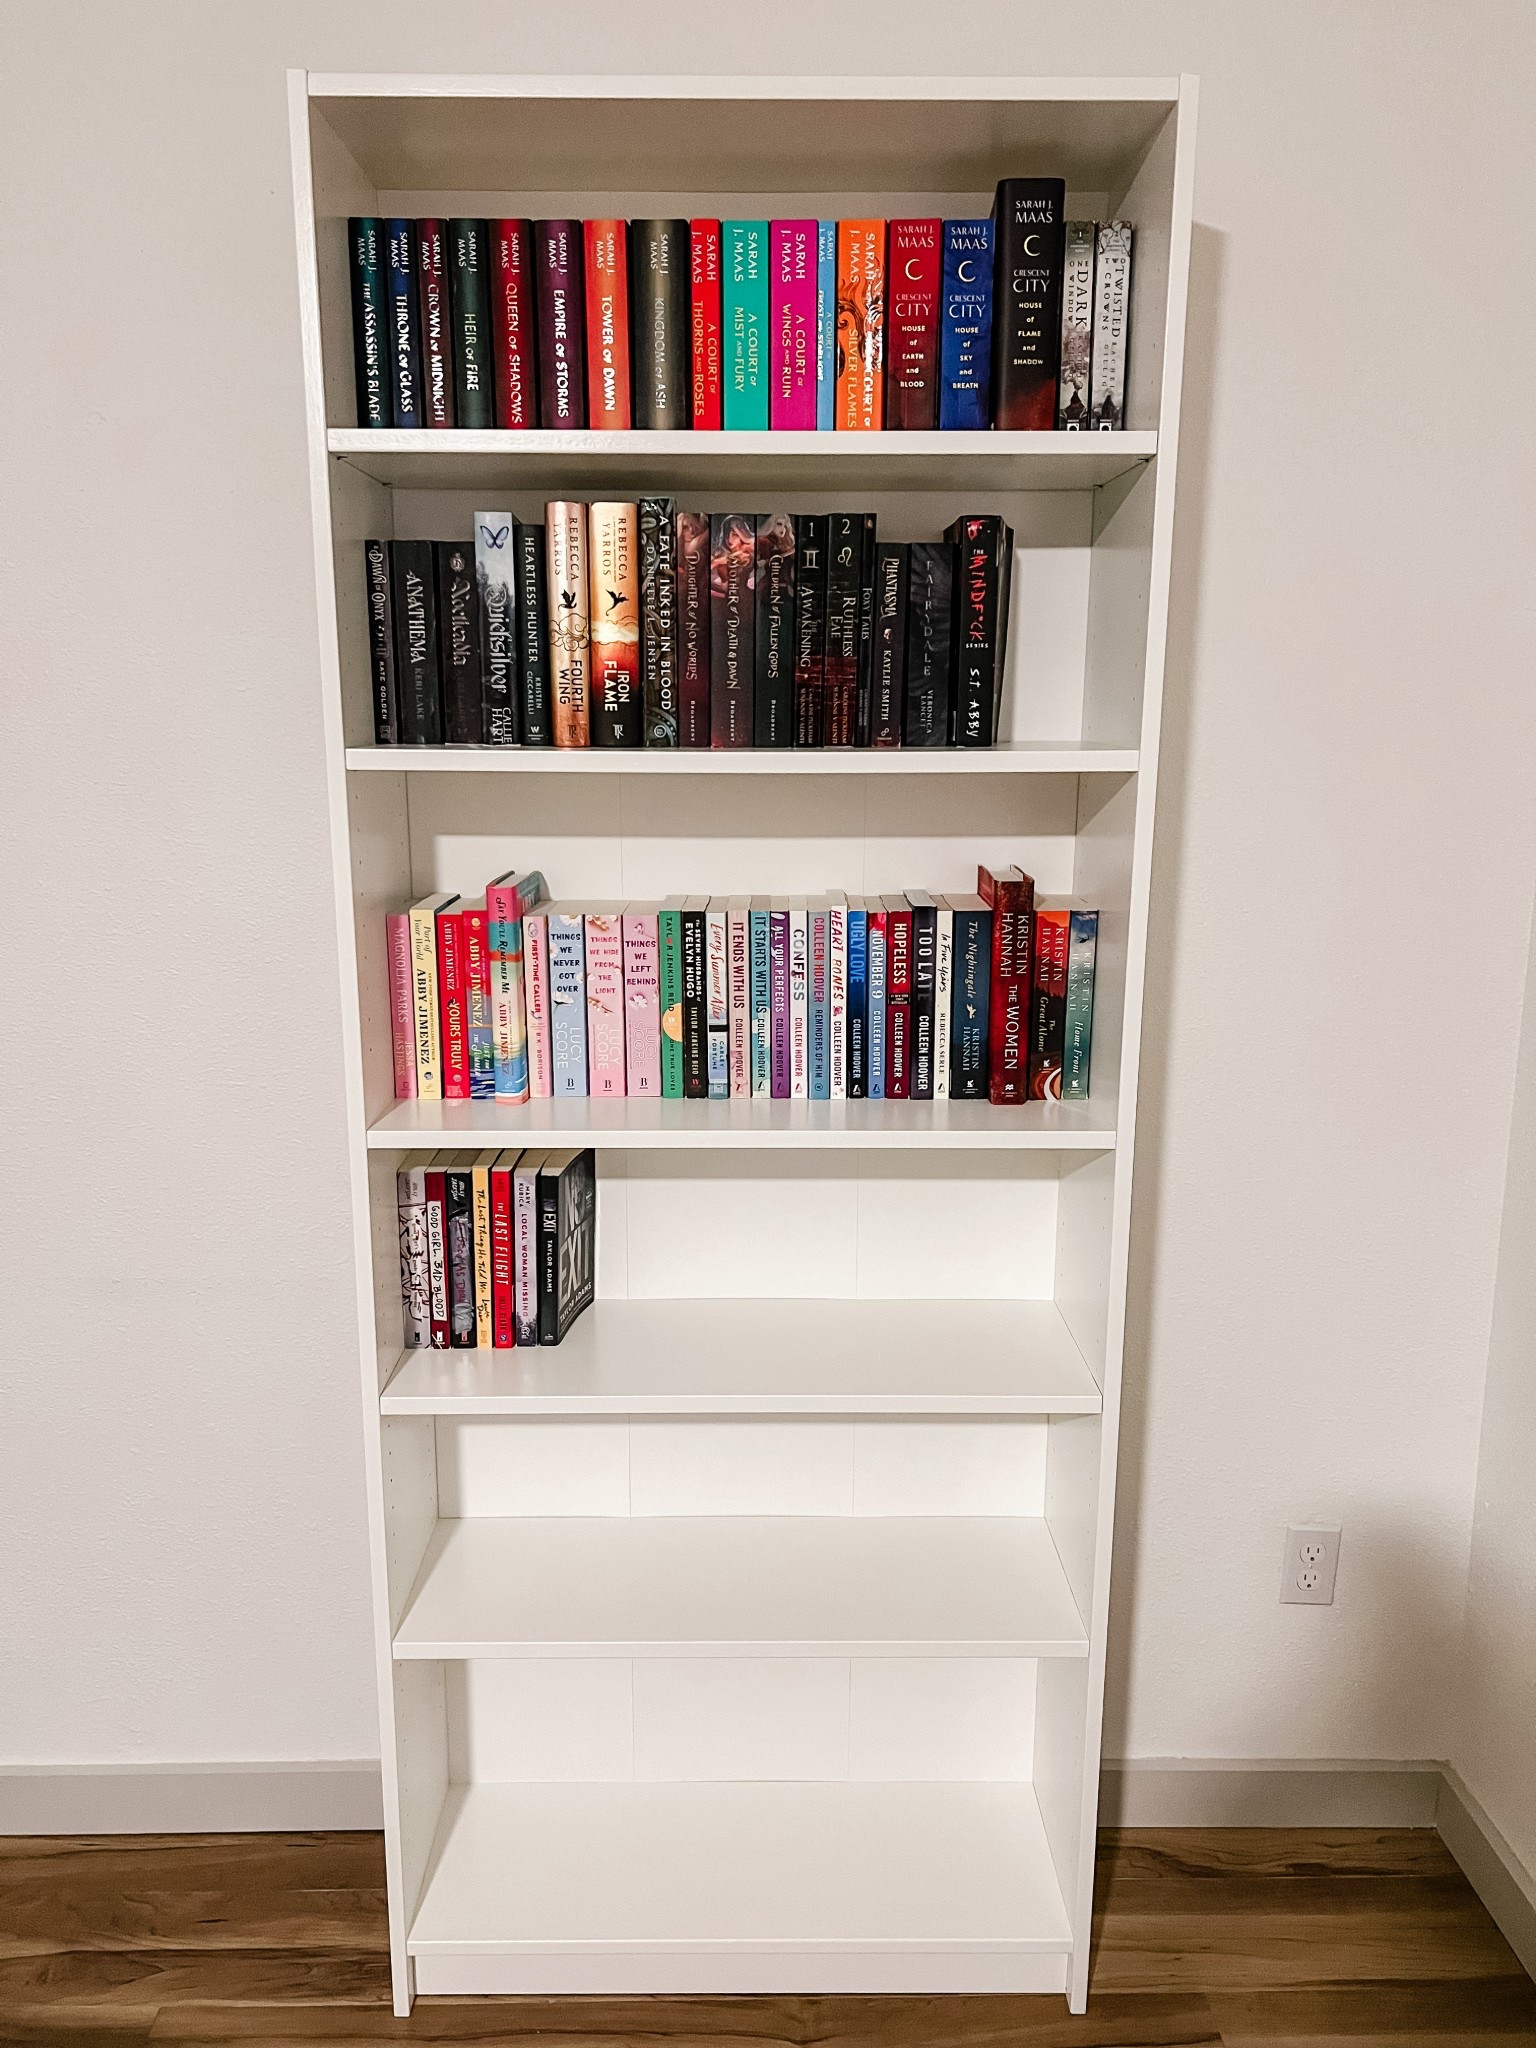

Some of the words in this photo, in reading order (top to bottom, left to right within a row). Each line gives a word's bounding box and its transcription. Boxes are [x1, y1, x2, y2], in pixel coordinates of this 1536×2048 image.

[1015, 212, 1053, 223] MAAS
[357, 237, 366, 266] MAAS
[368, 231, 377, 266] SARAH
[734, 241, 743, 282] MAAS
[748, 232, 758, 279] SARAH
[1013, 279, 1050, 292] CITY
[1076, 270, 1089, 327] DARK
[1102, 273, 1111, 330] CROWNS
[1112, 266, 1125, 337] TWISTED
[396, 294, 410, 351] THRONE
[428, 284, 440, 337] CROWN
[506, 283, 518, 331] QUEEN
[554, 290, 566, 339] EMPIRE
[602, 295, 614, 345] TOWER
[734, 307, 744, 338] MIST
[748, 313, 758, 323] A
[782, 304, 791, 347] WINGS
[364, 303, 378, 376] ASSASSIN'S
[465, 314, 476, 345] HEIR
[654, 298, 665, 363] KINGDOM
[694, 301, 704, 355] THORNS
[748, 328, 758, 374] COURT
[849, 330, 858, 377] SILVER
[399, 369, 413, 413] GLASS
[431, 354, 444, 422] MIDNIGHT
[466, 365, 479, 391] FIRE
[509, 355, 522, 423] SHADOWS
[556, 361, 569, 418] STORMS
[603, 368, 615, 411] DAWN
[694, 374, 704, 416] ROSES
[734, 358, 744, 392] FURY
[782, 367, 791, 398] RUIN
[368, 379, 380, 421] BLADE
[655, 383, 665, 409] ASH
[848, 378, 858, 428] FLAMES
[659, 516, 668, 525] A
[809, 522, 814, 536] 1
[842, 519, 850, 534] 2
[602, 524, 611, 576] YARROS
[618, 518, 627, 581] REBECCA
[659, 536, 669, 570] FATE
[525, 537, 536, 606] HEARTLESS
[880, 557, 900, 624] PHANTASMA
[406, 569, 426, 663] ANATHEMA
[659, 580, 670, 628] INKED
[862, 587, 872, 610] FOXY
[527, 611, 538, 662] HUNTER
[661, 637, 670, 651] IN
[800, 587, 814, 668] AWAKENING
[830, 616, 843, 638] FAE
[842, 597, 856, 657] RUTHLESS
[862, 614, 871, 640] TALES
[559, 670, 571, 704] WING
[571, 660, 584, 713] FOURTH
[604, 660, 618, 712] FLAME
[618, 671, 630, 703] IRON
[661, 661, 671, 710] BLOOD
[883, 650, 891, 685] KAYLIE
[881, 688, 890, 720] SMITH
[492, 708, 502, 743] HART
[502, 707, 512, 743] CALLIE
[444, 922, 453, 946] ABBY
[685, 923, 694, 967] EVELYN
[733, 922, 744, 931] IT
[775, 925, 783, 940] ALL
[814, 918, 824, 961] COLLEEN
[832, 910, 842, 952] HEART
[850, 921, 864, 950] UGLY
[919, 927, 933, 956] TOO
[969, 922, 977, 939] The
[1000, 913, 1014, 977] HANNAH
[1016, 915, 1029, 974] KRISTIN
[445, 948, 455, 990] JIMENEZ
[469, 936, 480, 966] ABBY
[532, 939, 540, 982] FIRST-TIME
[733, 935, 744, 963] ENDS
[775, 944, 783, 967] YOUR
[793, 929, 804, 1001] CONFESS
[850, 953, 864, 983] LOVE
[872, 930, 883, 987] NOVEMBER
[894, 923, 906, 984] HOPELESS
[417, 969, 426, 1003] ABBY
[686, 968, 694, 998] HUGO
[733, 966, 744, 994] WITH
[775, 969, 784, 1012] PERFECTS
[814, 964, 824, 1003] HOOVER
[832, 959, 843, 1000] BONES
[917, 962, 933, 1000] LATE
[964, 943, 977, 998] Nightingale
[469, 970, 483, 1027] JIMENEZ
[734, 997, 744, 1008] US
[872, 990, 883, 999] 9
[1008, 984, 1018, 1002] THE
[418, 1007, 429, 1064] JIMENEZ
[449, 1002, 461, 1038] YOURS
[919, 1016, 929, 1052] COLLEEN
[1005, 1005, 1019, 1070] WOMEN
[449, 1039, 462, 1070] TRULY
[556, 1023, 568, 1069] SCORE
[569, 1028, 581, 1064] LUCY
[918, 1053, 928, 1090] HOOVER
[430, 1205, 439, 1228] GOOD
[495, 1214, 507, 1241] LAST
[543, 1212, 556, 1232] EXIT
[433, 1260, 443, 1282] BAD
[495, 1245, 508, 1285] FLIGHT
[433, 1287, 444, 1318] BLOOD
